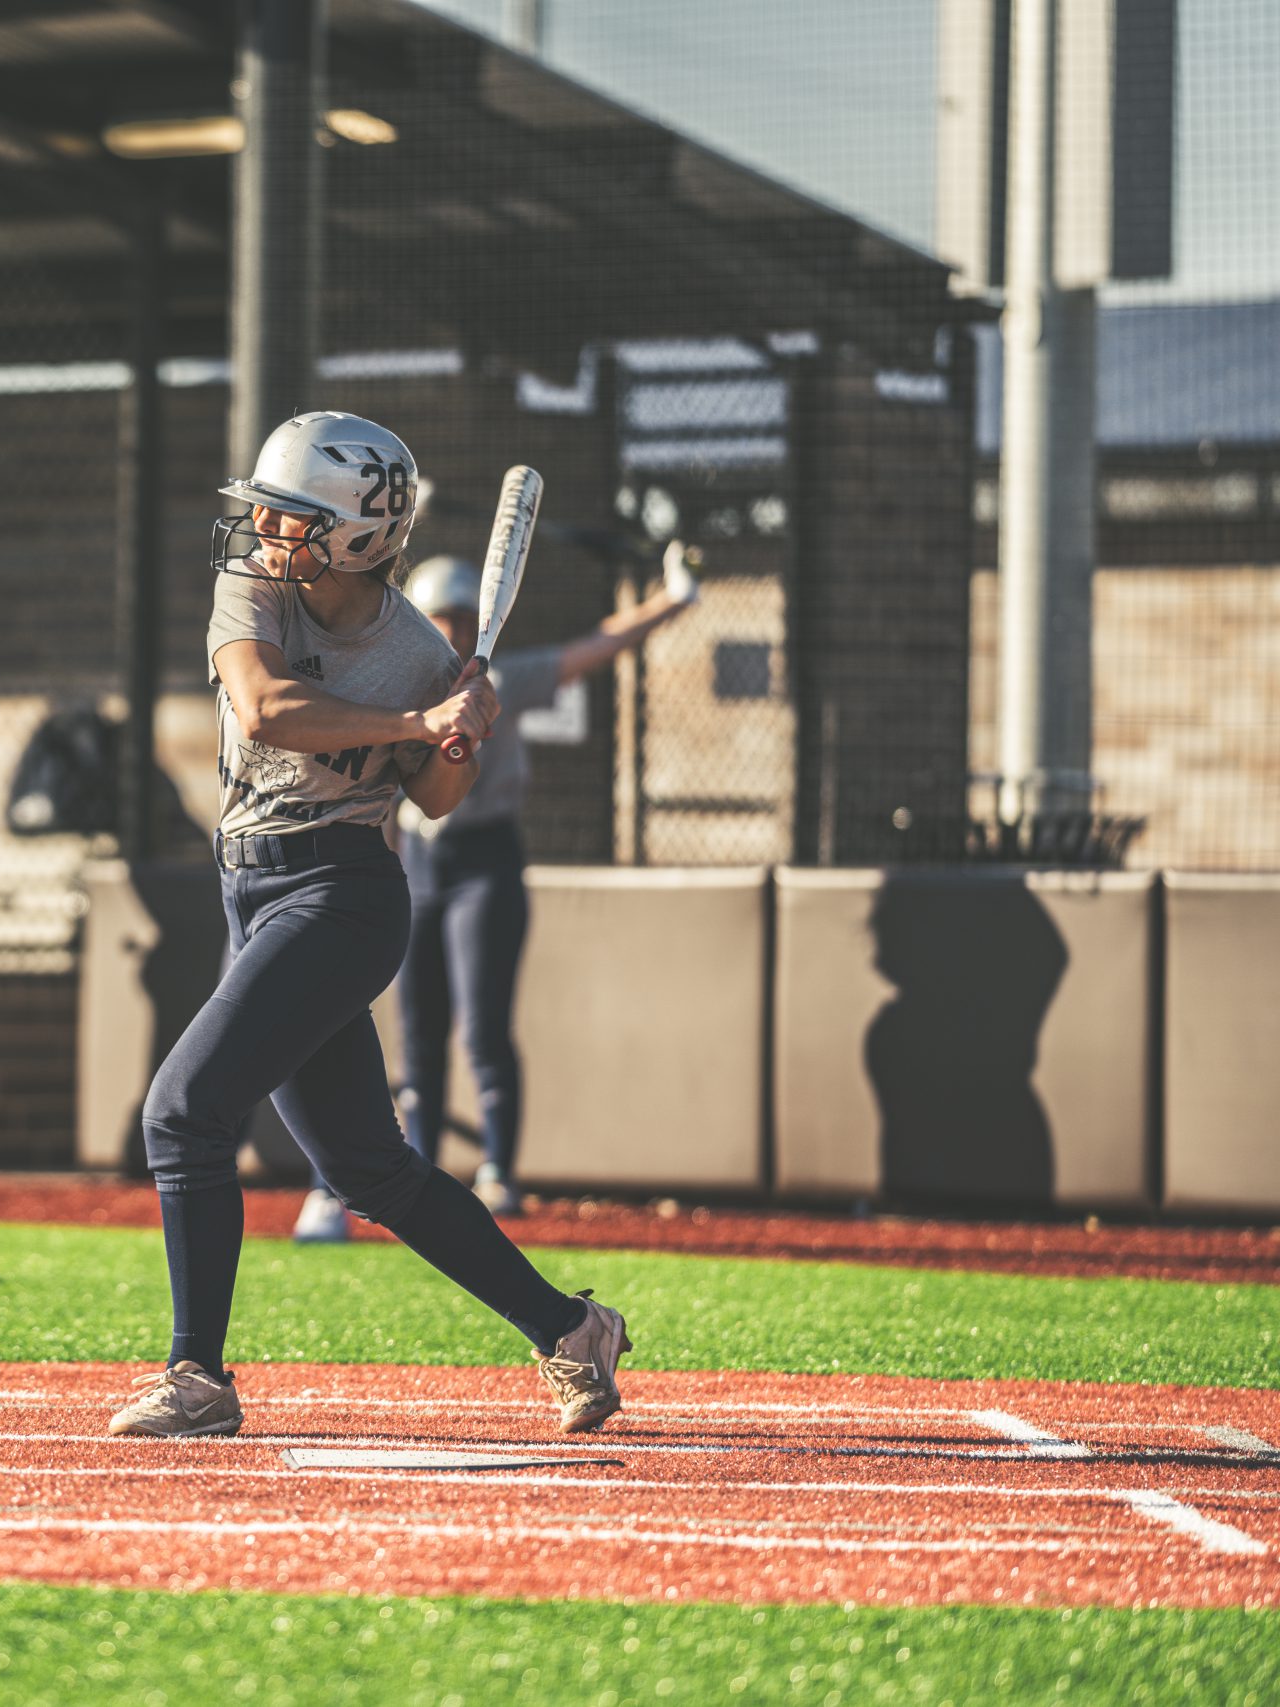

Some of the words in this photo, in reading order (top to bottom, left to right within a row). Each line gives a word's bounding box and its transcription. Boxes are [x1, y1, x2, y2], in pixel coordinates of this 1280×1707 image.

[360, 462, 408, 518] 28
[488, 474, 527, 569] EASTON
[291, 659, 325, 681] adidas
